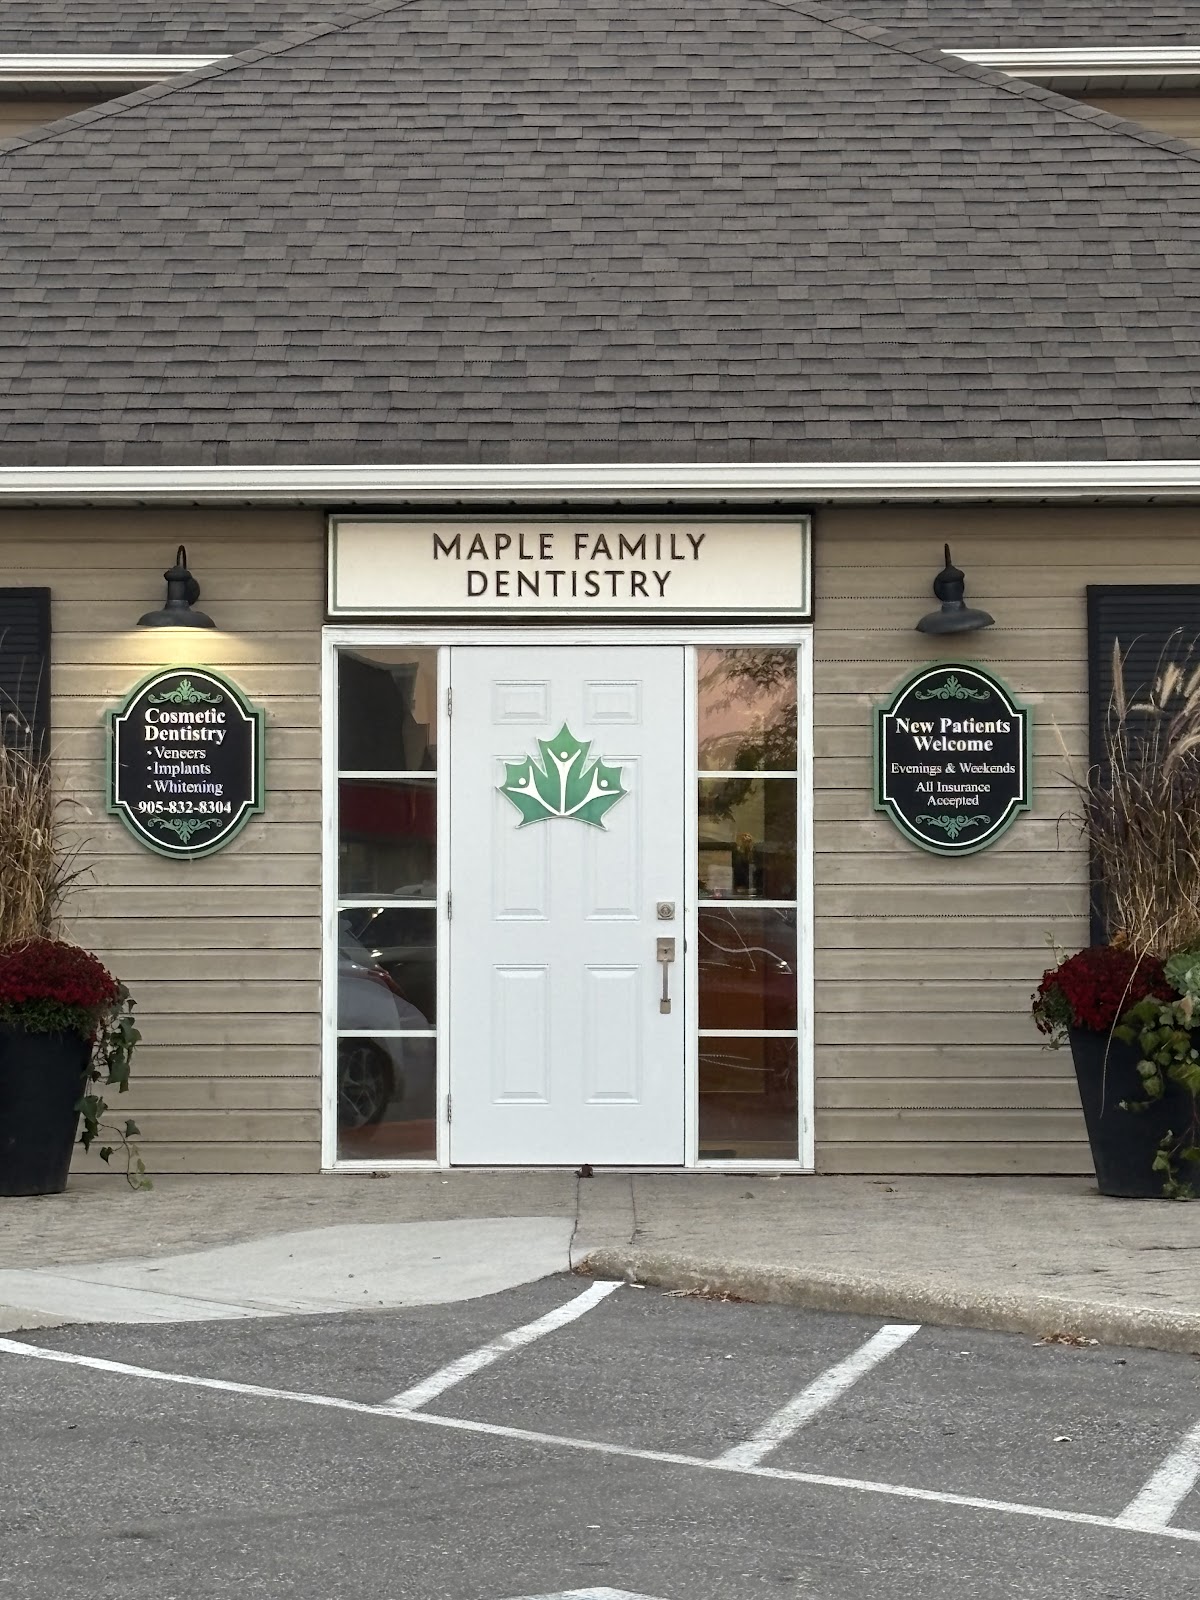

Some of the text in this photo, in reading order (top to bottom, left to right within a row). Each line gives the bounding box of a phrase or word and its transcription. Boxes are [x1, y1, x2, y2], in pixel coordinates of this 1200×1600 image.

[432, 532, 707, 561] MAPLE FAMILY
[466, 570, 672, 598] DENTISTRY
[144, 708, 226, 724] Cosmetic
[895, 717, 1011, 733] New Patients
[144, 725, 227, 745] Dentistry
[912, 736, 994, 751] Welcome
[154, 746, 206, 759] Veneers
[153, 761, 212, 777] Implants
[890, 762, 1016, 776] Evenings & Weekends
[154, 780, 224, 796] Whitening
[915, 782, 991, 792] All Insurance
[138, 801, 232, 814] 905-832-8304
[927, 795, 980, 808] Accepted
